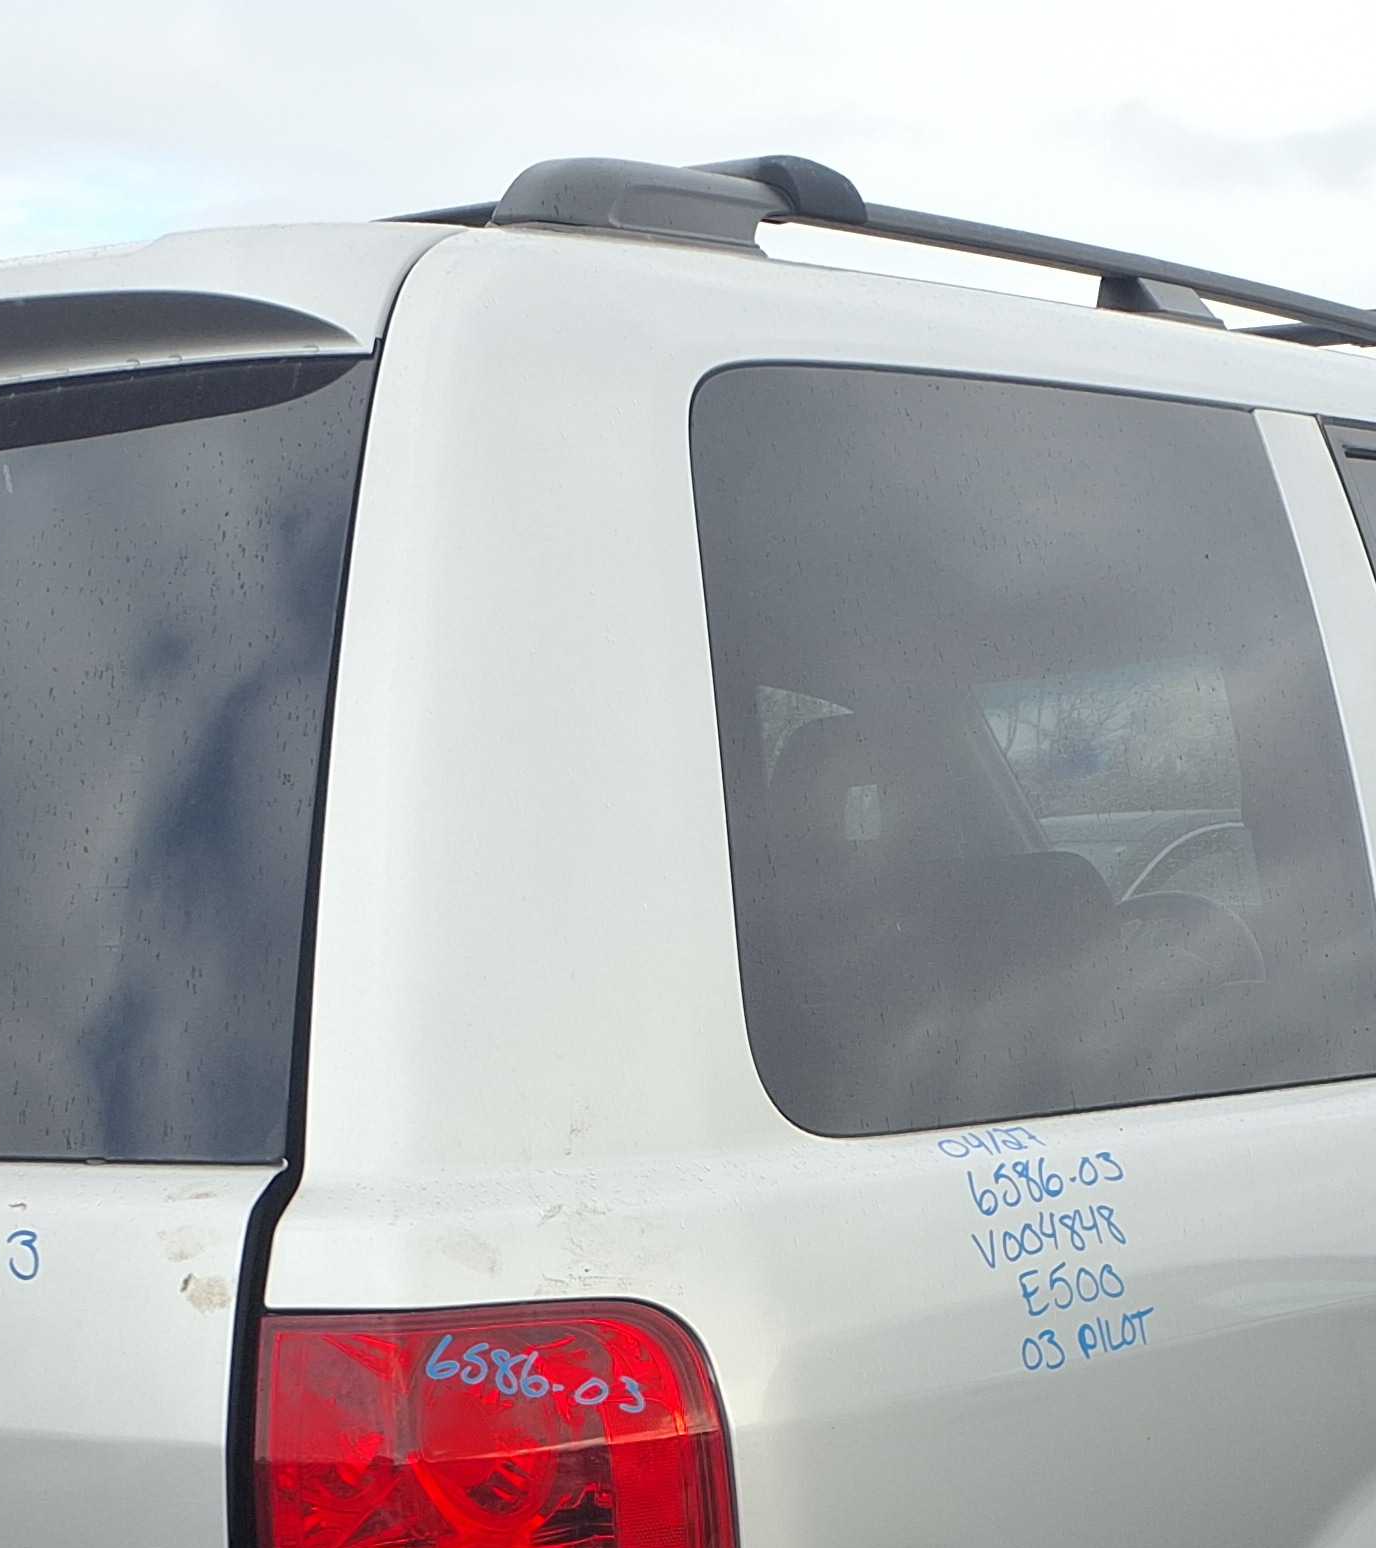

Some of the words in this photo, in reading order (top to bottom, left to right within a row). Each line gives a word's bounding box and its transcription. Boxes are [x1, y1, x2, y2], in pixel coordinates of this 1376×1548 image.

[971, 1204, 1127, 1269] V004848
[1021, 1328, 1066, 1371] 03
[1077, 1306, 1155, 1359] PILOT
[425, 1334, 646, 1414] 6586-03
